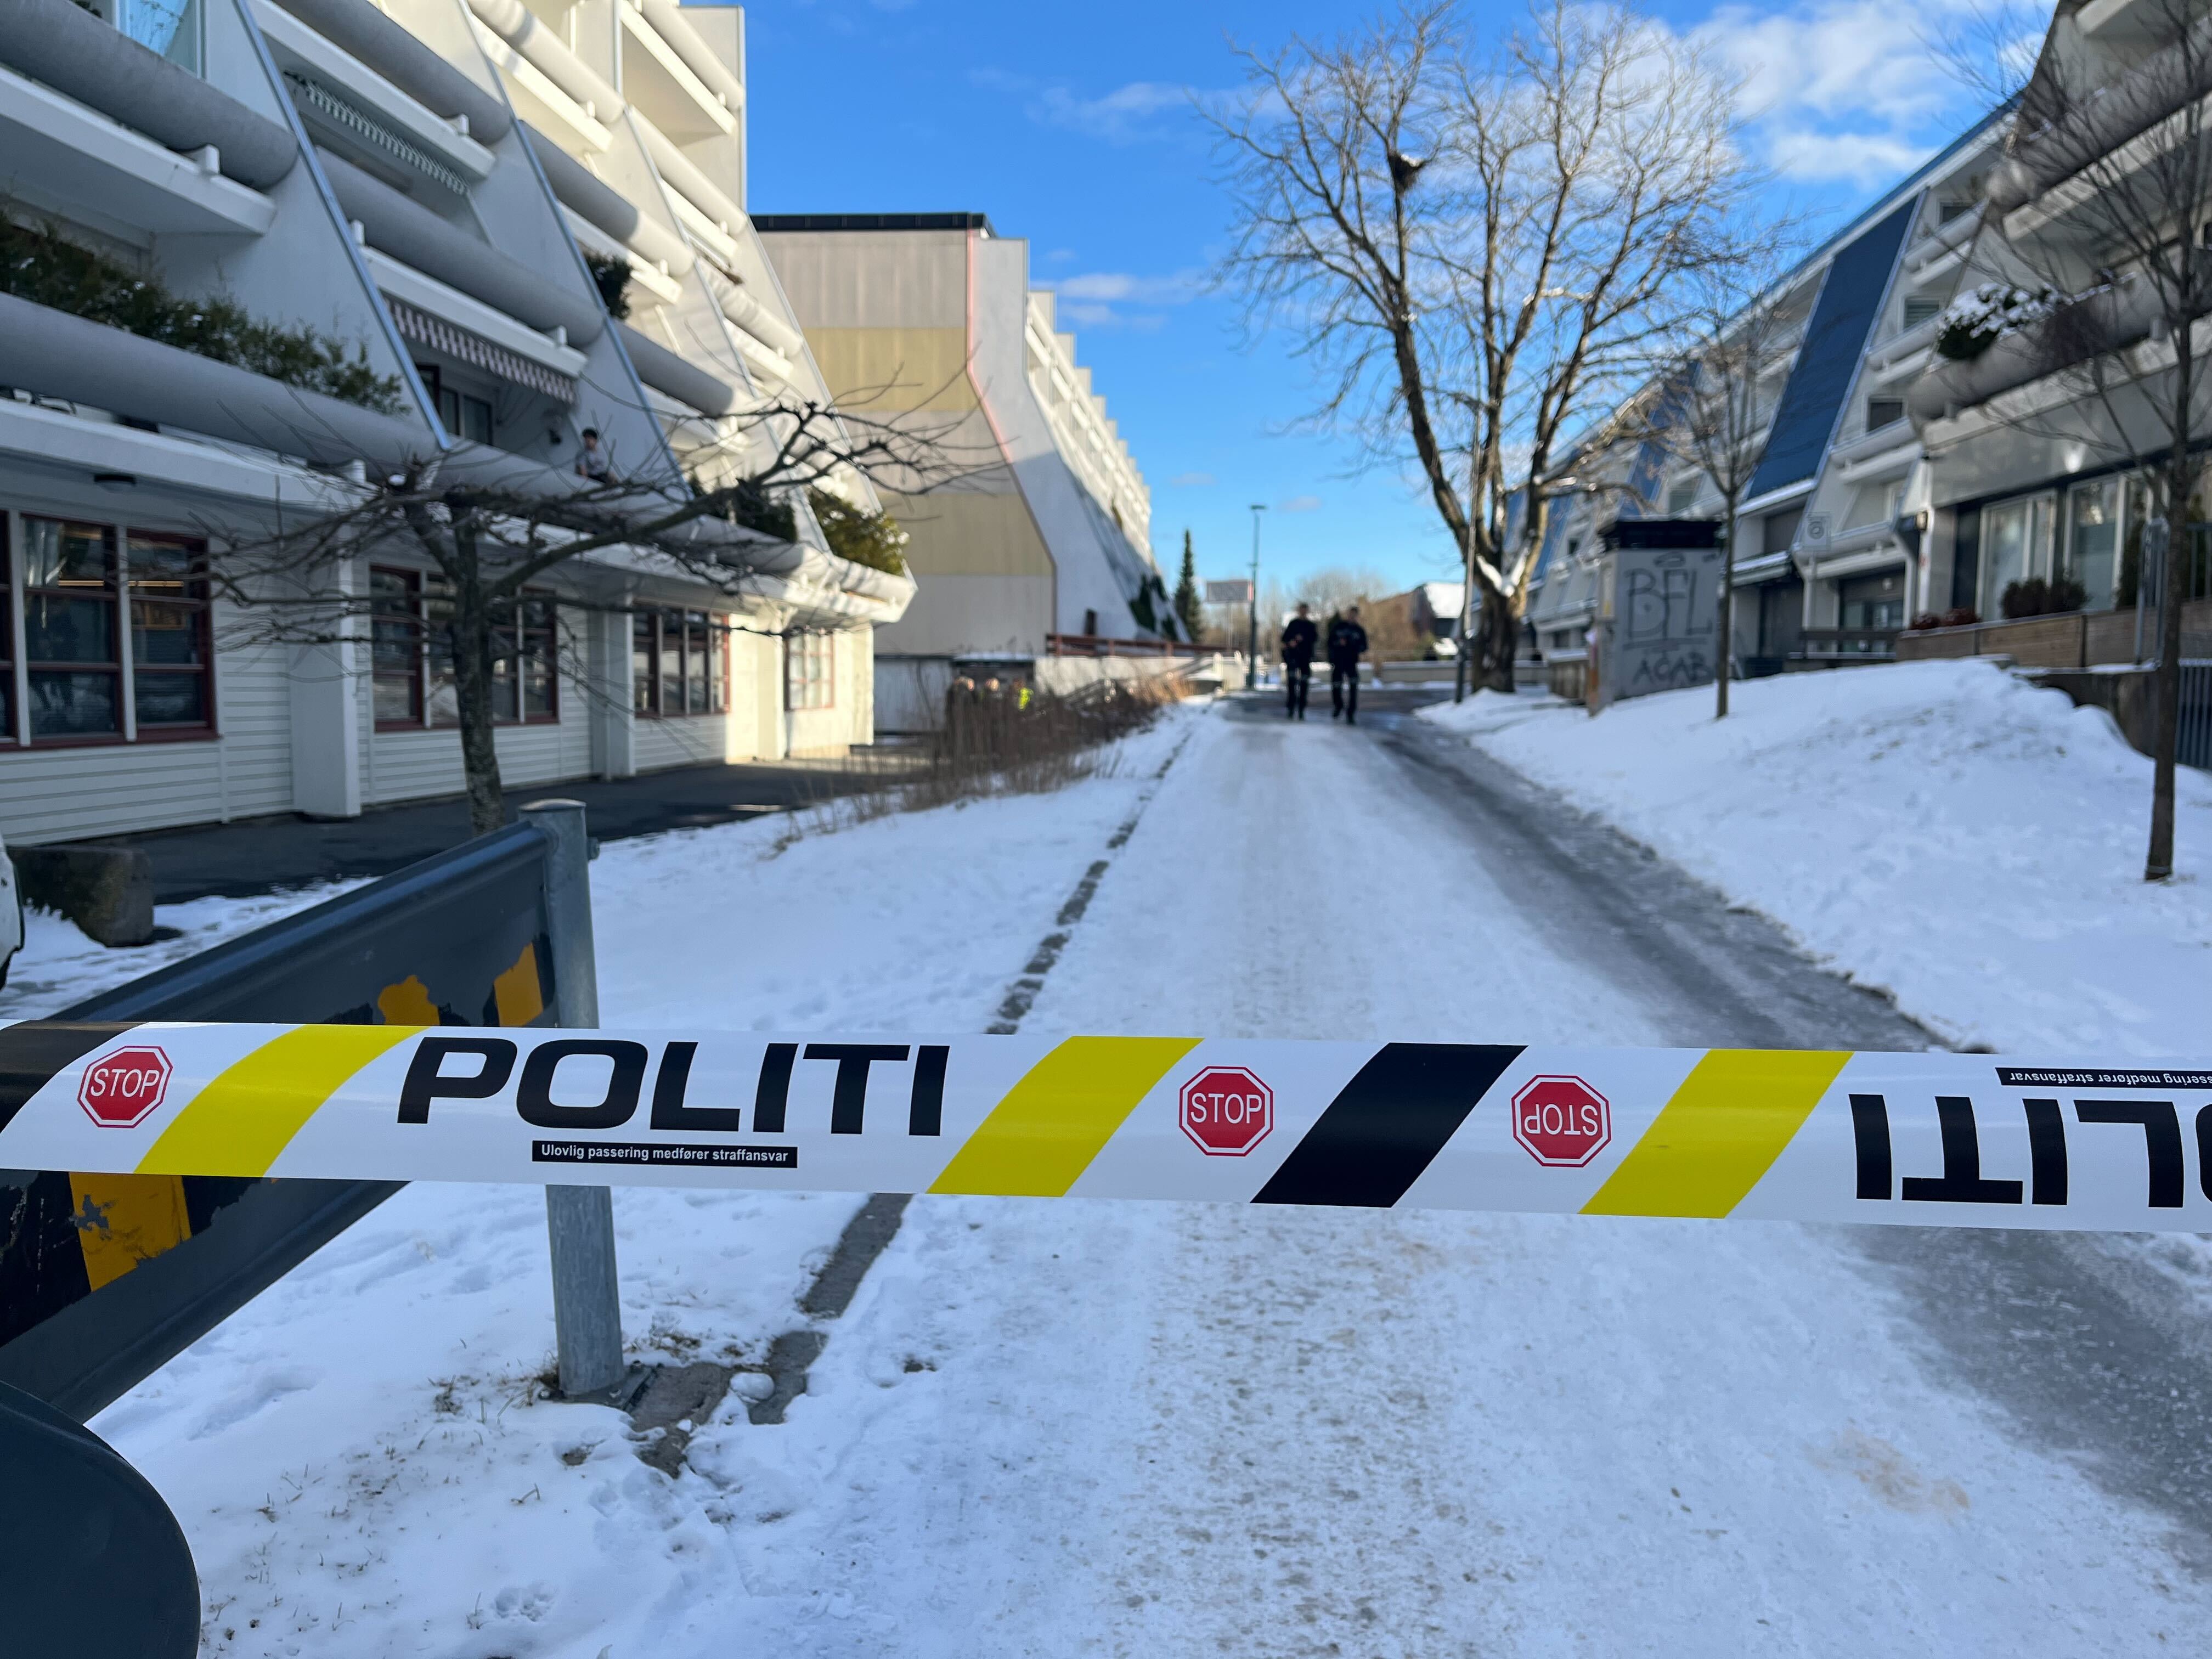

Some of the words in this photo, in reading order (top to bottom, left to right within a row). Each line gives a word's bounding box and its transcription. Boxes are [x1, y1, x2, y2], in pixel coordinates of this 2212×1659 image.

[89, 1068, 161, 1099] STOP
[397, 1036, 950, 1136] POLITI
[2010, 1071, 2094, 1085] straffansvar
[2098, 1073, 2161, 1086] medfører
[1189, 1092, 1262, 1124] STOP
[1524, 1103, 1599, 1137] STOP
[541, 1144, 584, 1159] Ulovlig
[588, 1147, 648, 1161] passering
[652, 1147, 710, 1160] medfører
[712, 1148, 788, 1162] straffansvar
